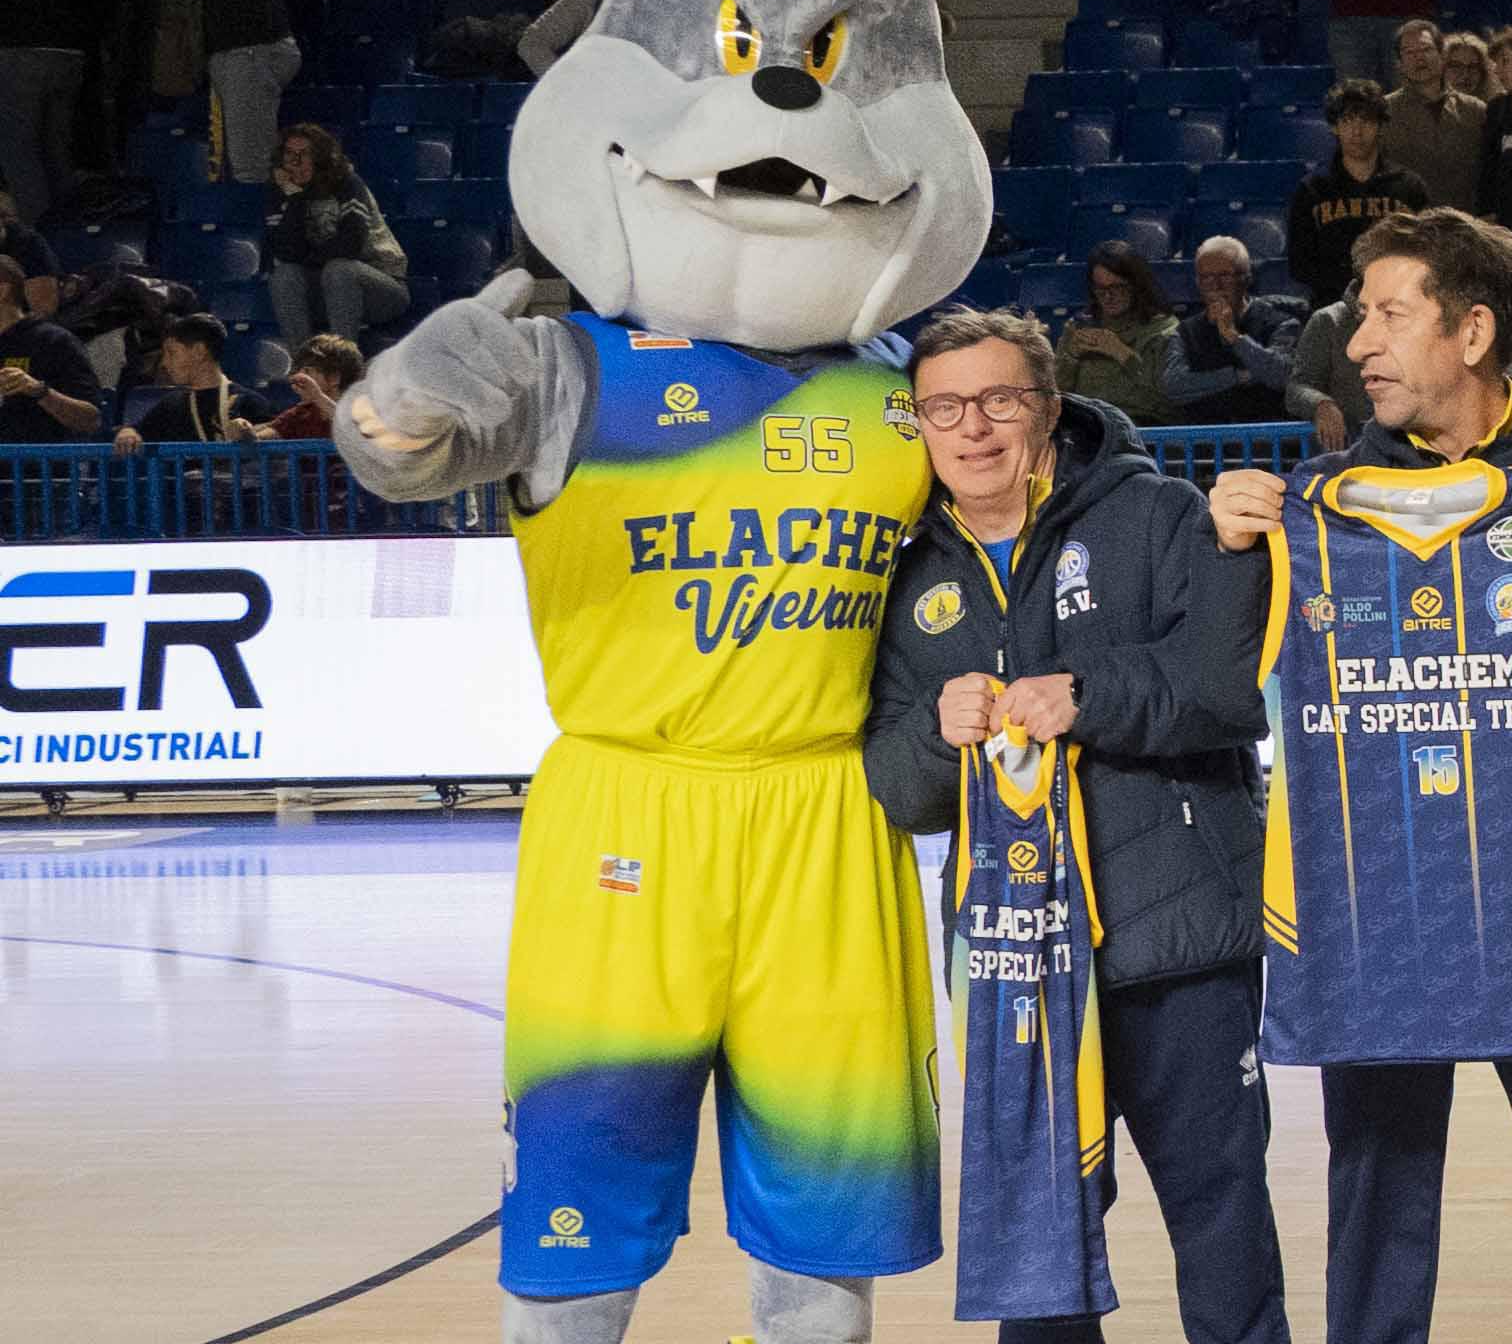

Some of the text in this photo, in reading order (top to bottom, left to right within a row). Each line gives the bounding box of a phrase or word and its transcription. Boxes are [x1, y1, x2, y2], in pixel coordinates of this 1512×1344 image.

[657, 409, 710, 426] BITRE
[761, 414, 854, 474] 55
[624, 507, 906, 580] ELACHE
[675, 574, 882, 654] Vigevan
[1056, 590, 1097, 620] G.V.
[1342, 602, 1373, 613] ALDO
[1342, 611, 1387, 624] POLLINI
[1403, 617, 1453, 631] BITRE
[0, 568, 272, 713] ER
[1302, 703, 1350, 735] CAT
[1360, 701, 1477, 734] SPECIAL
[34, 731, 262, 763] INDUSTRIALI
[1411, 744, 1460, 796] 15
[1008, 870, 1047, 885] ITRE
[539, 1234, 590, 1248] BITRE
